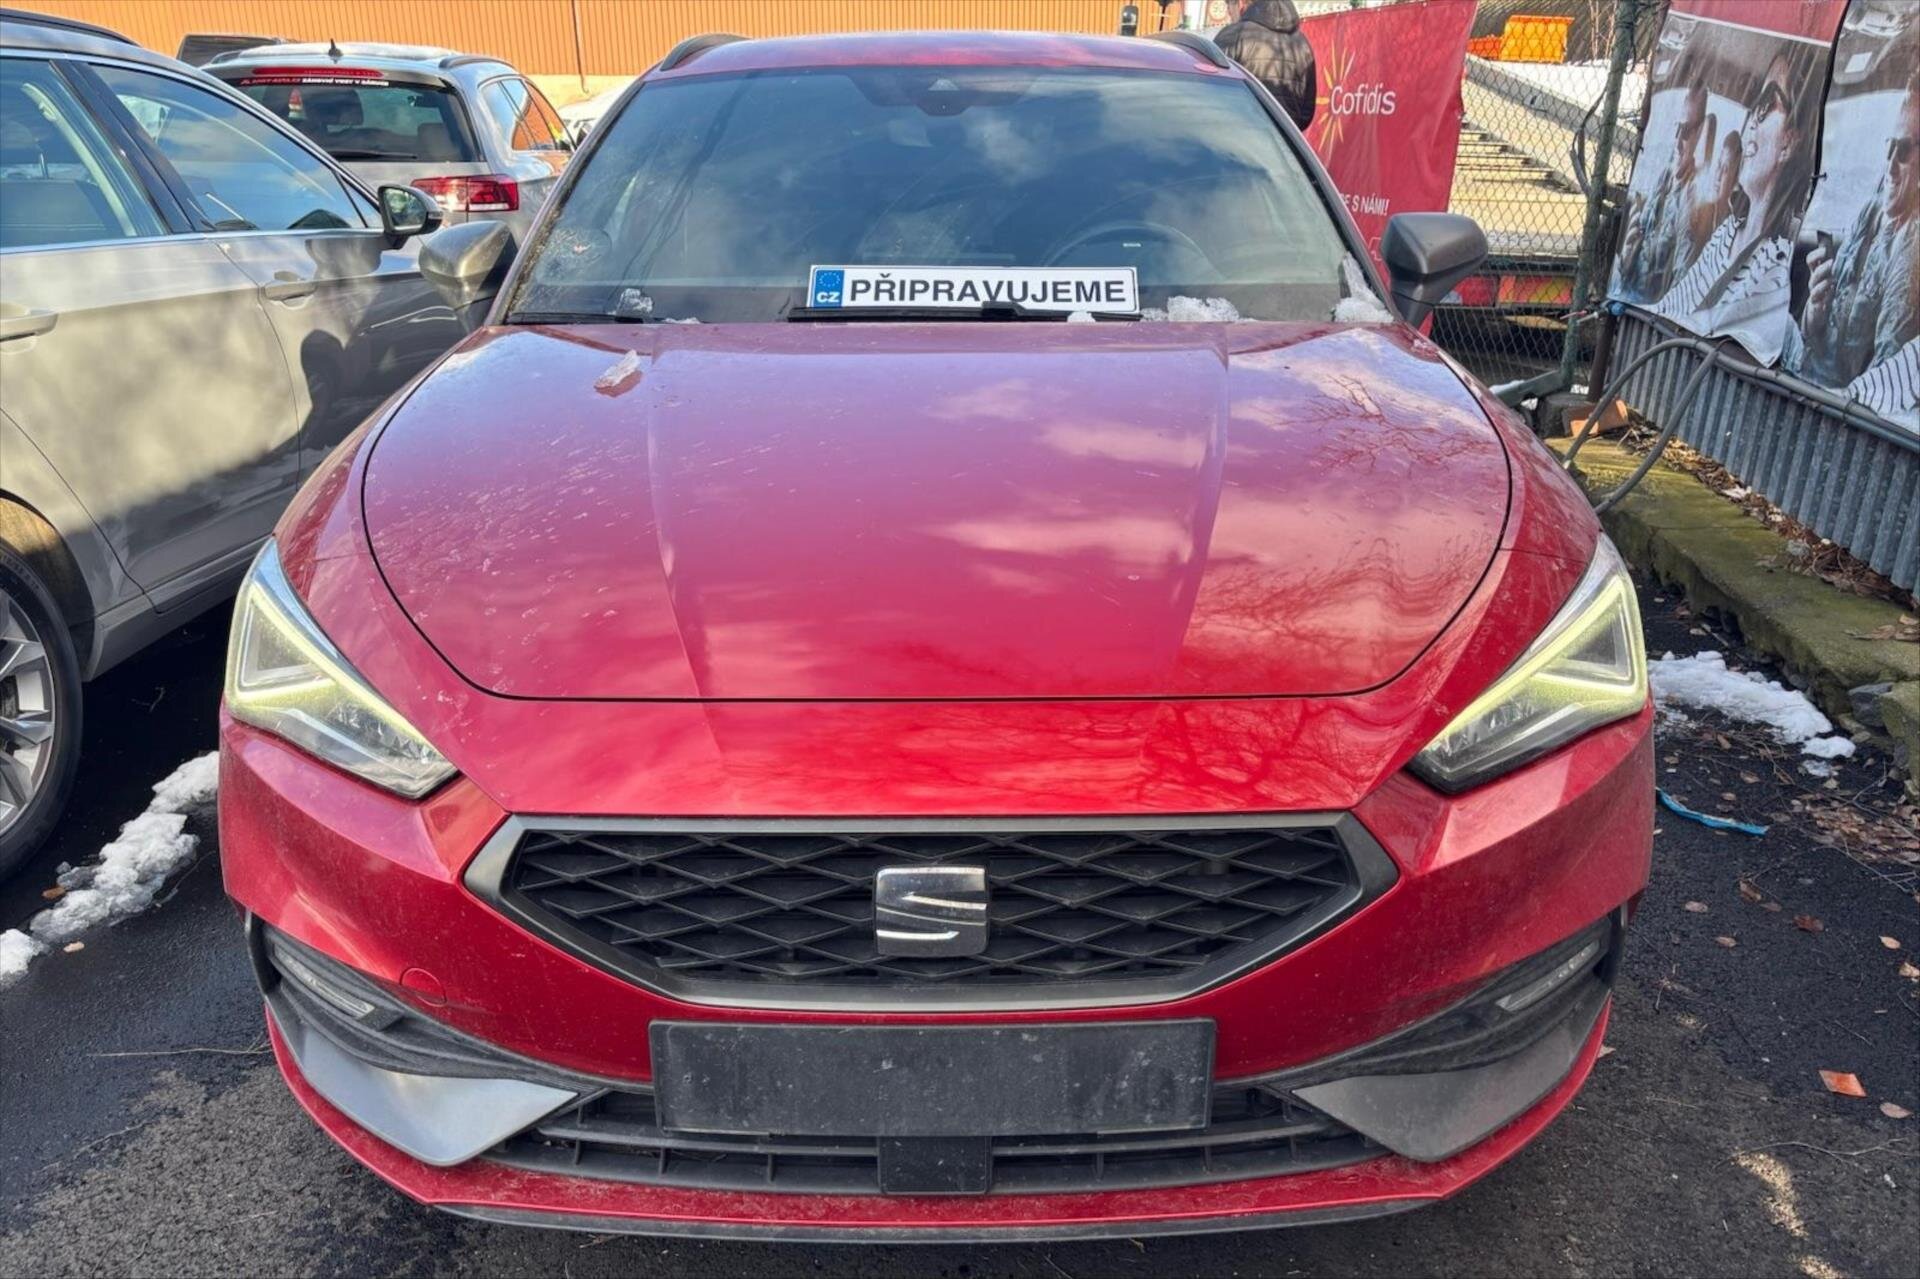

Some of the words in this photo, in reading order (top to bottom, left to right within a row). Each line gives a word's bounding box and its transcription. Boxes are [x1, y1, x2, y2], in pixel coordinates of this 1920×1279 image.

[1331, 82, 1396, 115] Cofidis
[1351, 194, 1360, 212] S
[815, 291, 841, 303] CZ
[850, 272, 1126, 303] PŘIPRAVUJEME
